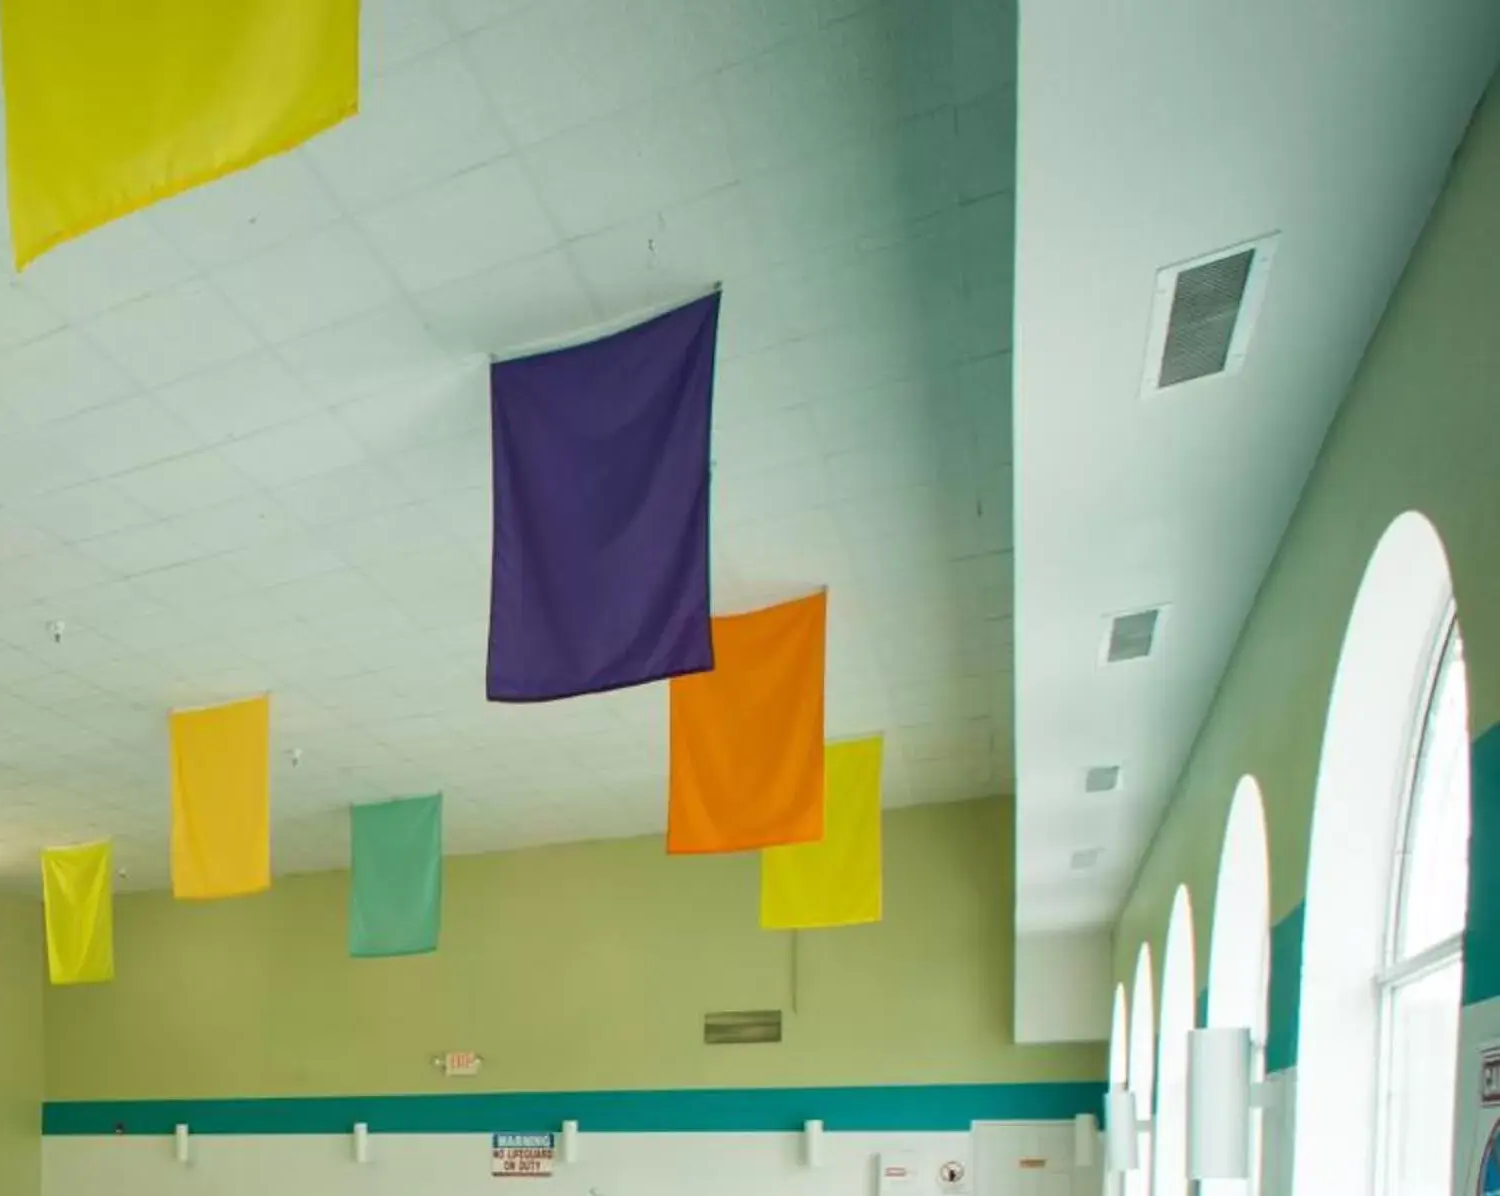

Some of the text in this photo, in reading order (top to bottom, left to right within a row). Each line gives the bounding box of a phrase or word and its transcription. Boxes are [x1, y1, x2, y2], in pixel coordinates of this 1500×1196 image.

[498, 1135, 549, 1147] WARNING
[493, 1149, 552, 1159] NO LIFEGUARD
[504, 1160, 541, 1170] ON DUTY
